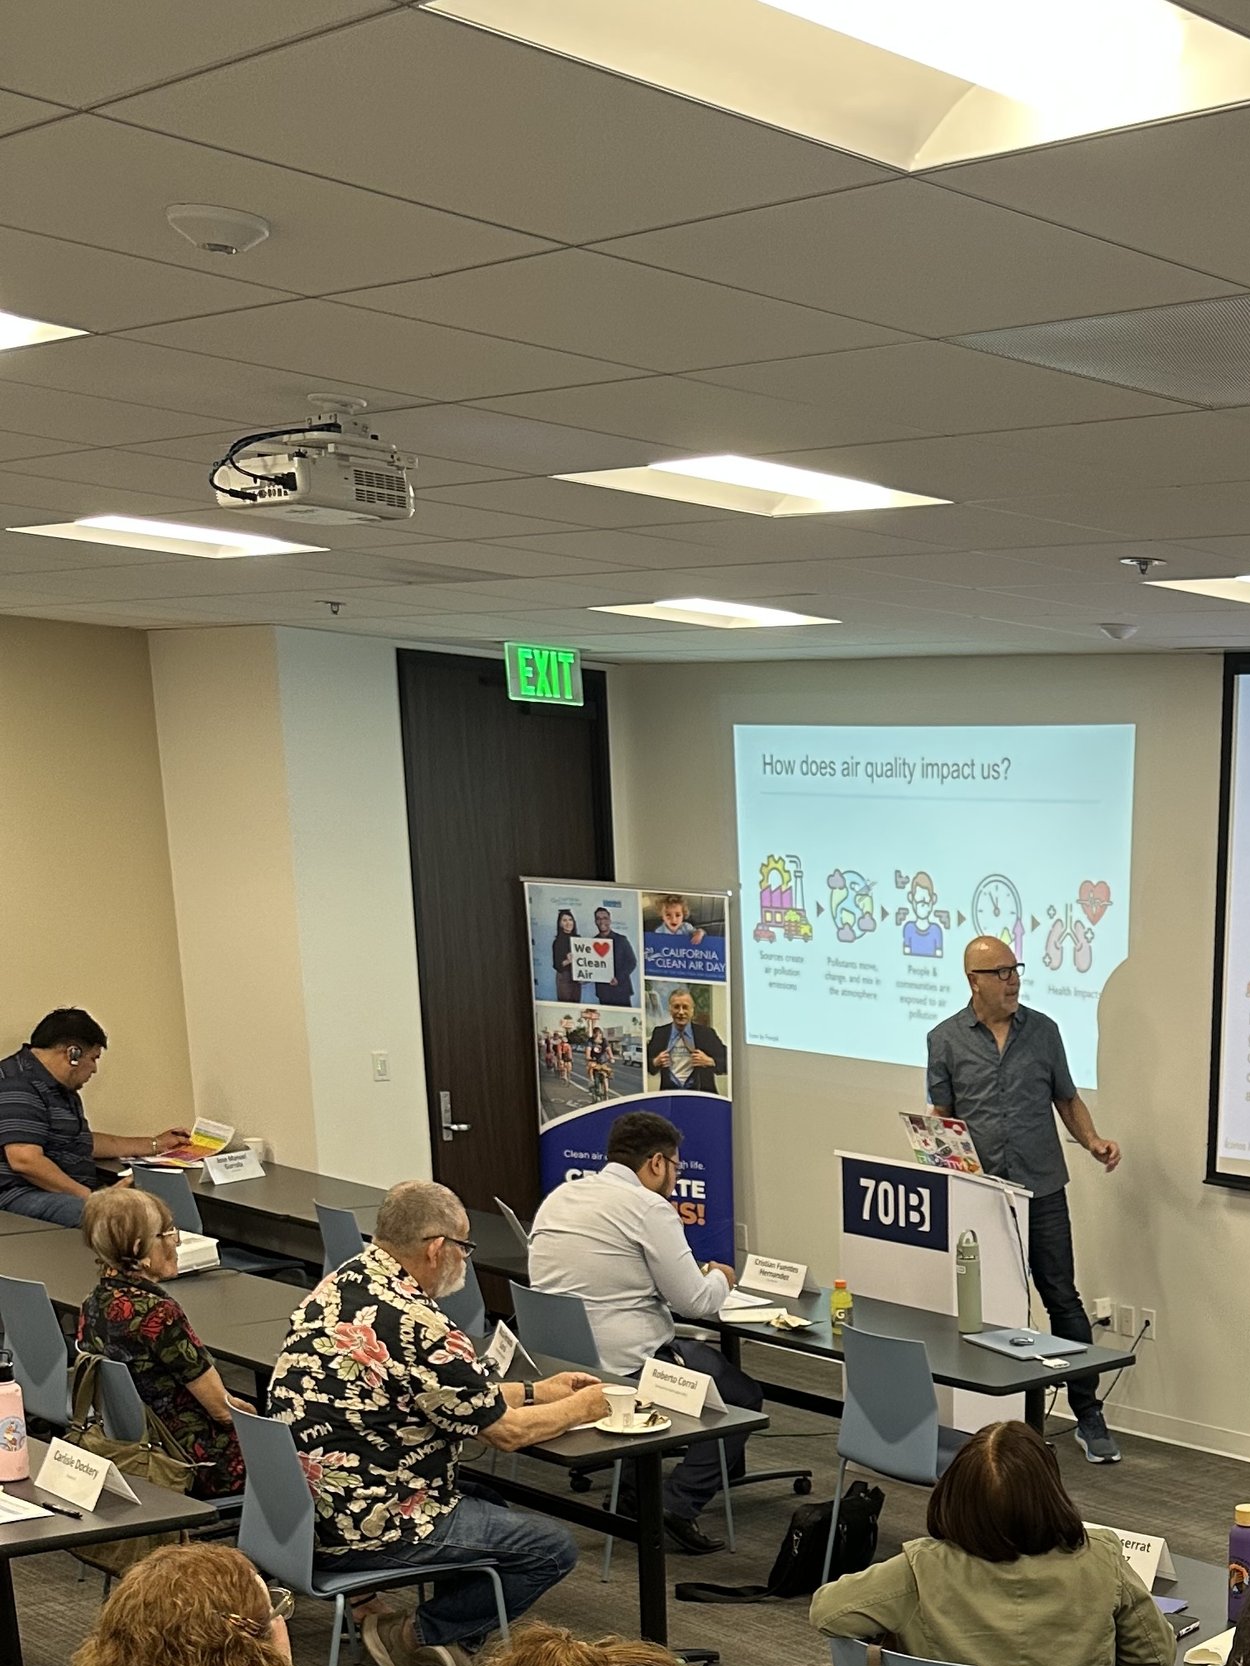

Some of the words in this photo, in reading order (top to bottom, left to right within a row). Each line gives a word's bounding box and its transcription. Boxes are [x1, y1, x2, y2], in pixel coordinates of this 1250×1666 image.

[518, 648, 574, 699] EXIT
[762, 754, 796, 776] How
[800, 755, 836, 777] does
[841, 756, 860, 778] air
[865, 757, 916, 784] quality
[921, 757, 976, 785] impact
[981, 757, 1011, 781] us?
[574, 943, 592, 954] We
[662, 947, 719, 961] CALIFORNIA
[577, 957, 607, 968] Clean
[759, 950, 784, 962] Sources
[785, 953, 804, 964] create
[827, 957, 857, 970] Pollutants
[656, 958, 686, 969] CLEAN
[688, 961, 704, 971] AIR
[706, 962, 727, 973] DAY
[907, 965, 930, 977] People
[577, 970, 593, 980] Air
[774, 967, 800, 978] pollution
[768, 981, 797, 991] emissions
[850, 975, 861, 984] and
[829, 986, 839, 996] the
[841, 988, 877, 1000] atmosphere
[896, 980, 937, 992] communities
[939, 983, 950, 993] are
[1048, 985, 1072, 997] Health
[899, 994, 927, 1007] exposed
[563, 1150, 590, 1161] Clean
[591, 1153, 603, 1161] air
[690, 1160, 706, 1171] life.
[836, 1309, 845, 1319] G
[652, 1368, 678, 1385] Roberto
[678, 1375, 698, 1390] Corral
[54, 1450, 75, 1467] Carlisle
[1120, 1539, 1152, 1553] serrat
